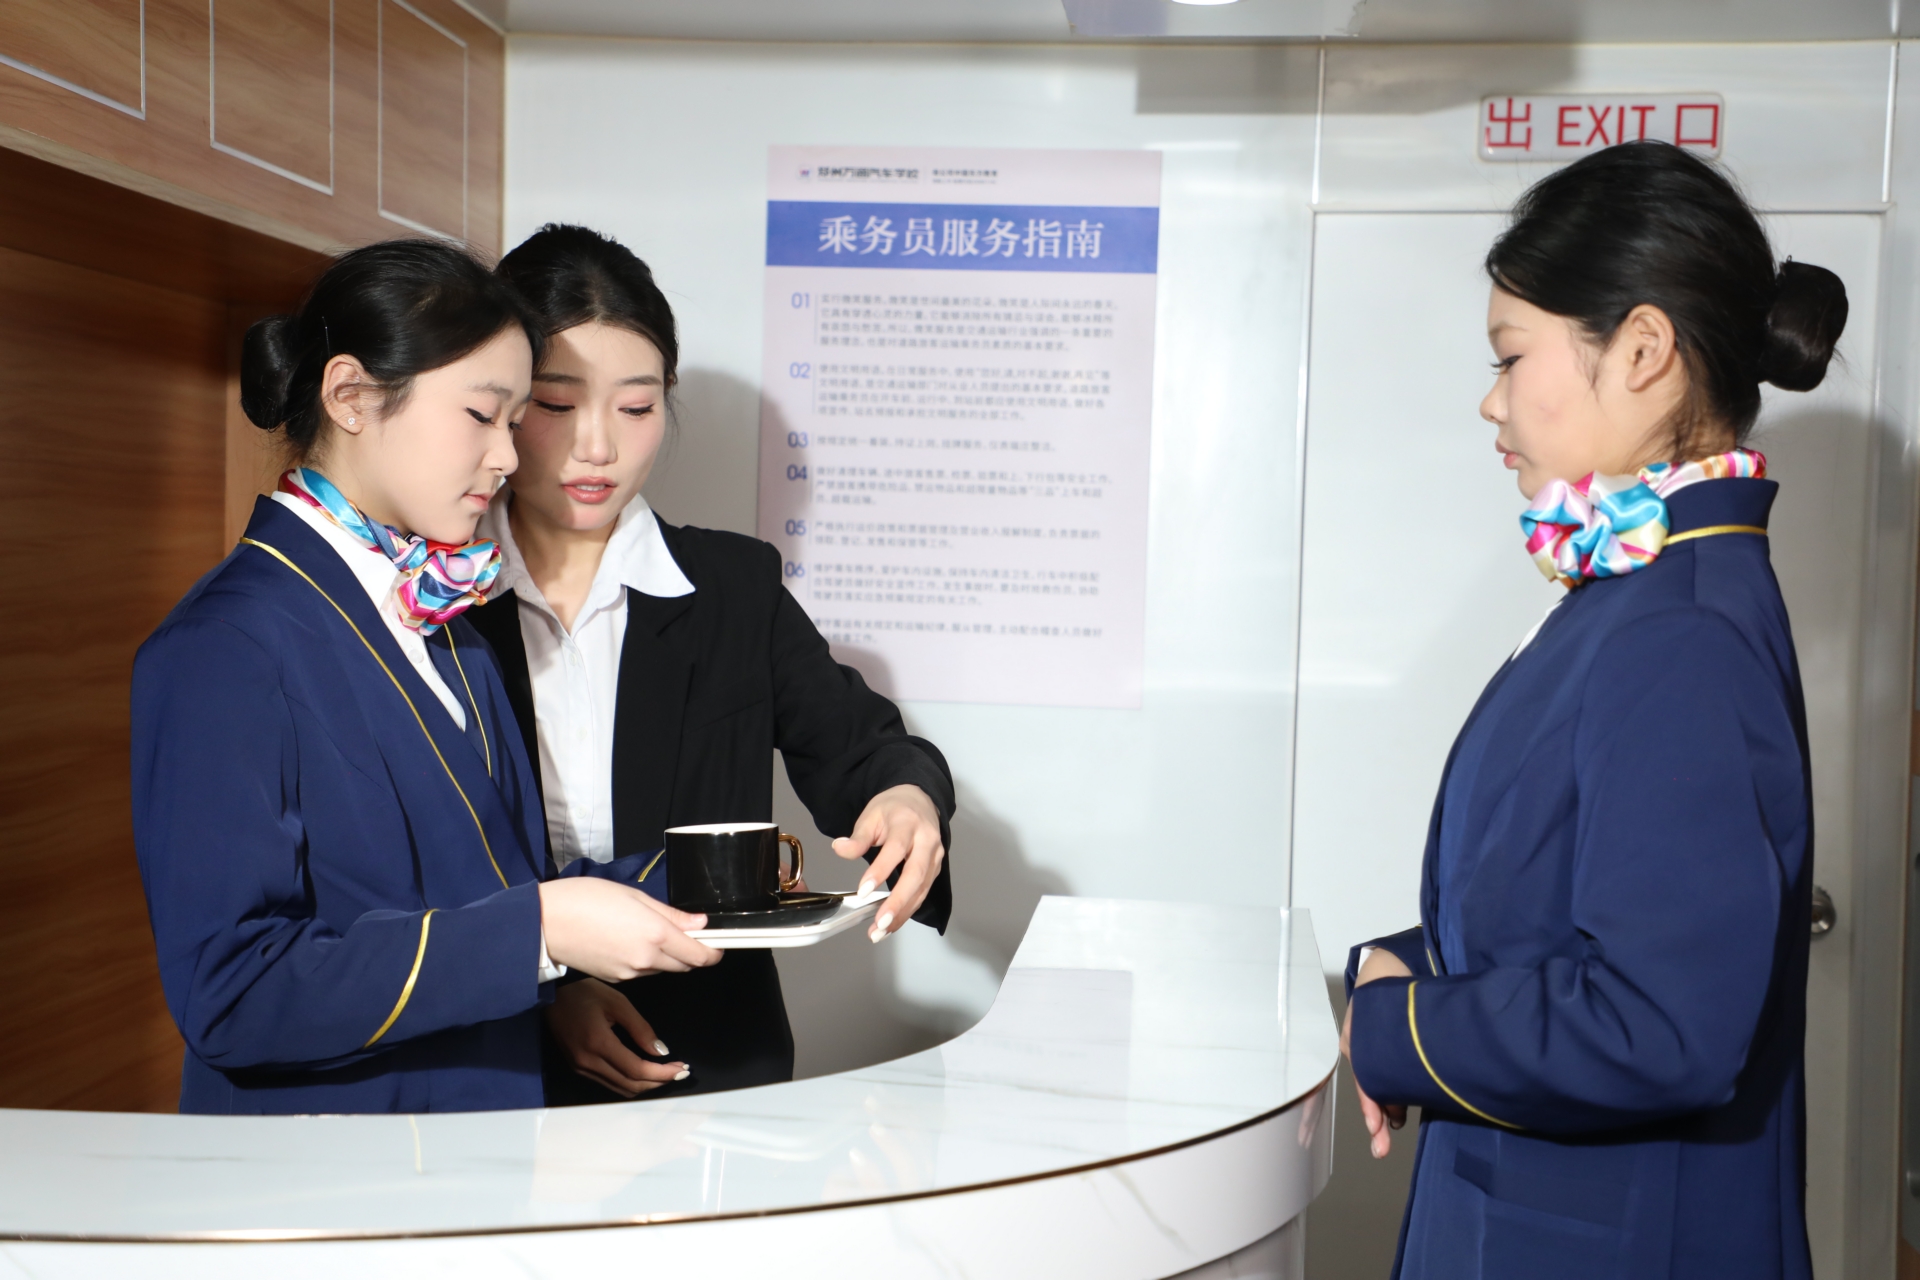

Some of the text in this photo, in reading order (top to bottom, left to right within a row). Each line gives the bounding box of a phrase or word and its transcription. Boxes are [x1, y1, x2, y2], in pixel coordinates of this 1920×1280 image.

[1485, 98, 1719, 150] 出 EXIT 口
[818, 215, 1104, 259] 乘务员服务指南
[791, 292, 810, 309] 01
[789, 362, 811, 379] 02
[787, 431, 808, 448] 03
[786, 464, 807, 481] 04
[785, 519, 806, 536] 05
[784, 561, 805, 578] 06
